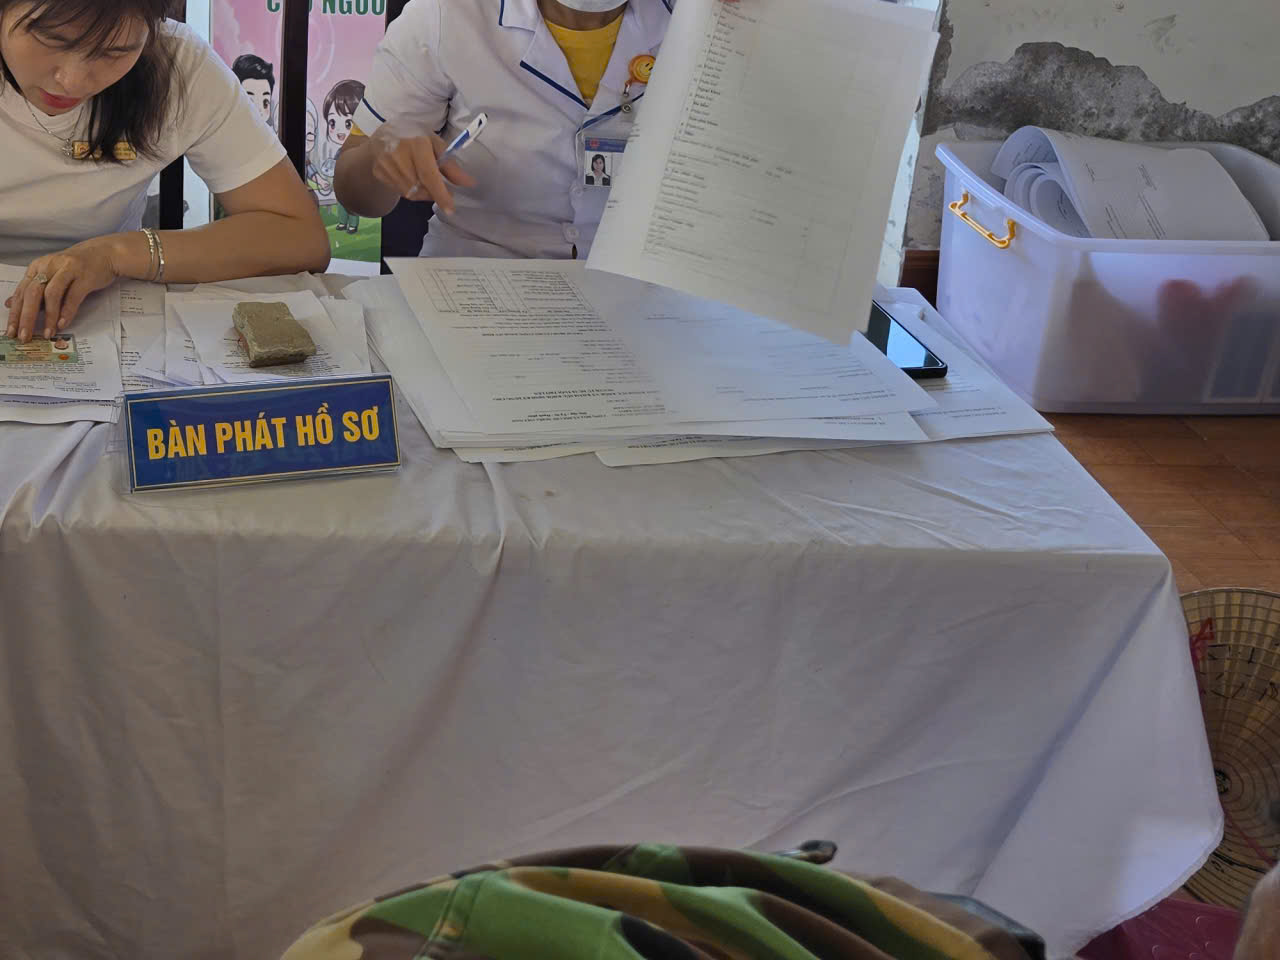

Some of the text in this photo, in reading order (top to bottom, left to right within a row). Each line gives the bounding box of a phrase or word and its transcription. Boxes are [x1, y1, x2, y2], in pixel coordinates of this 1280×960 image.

[146, 402, 380, 460] BÀN PHÁT HỒ SƠ
